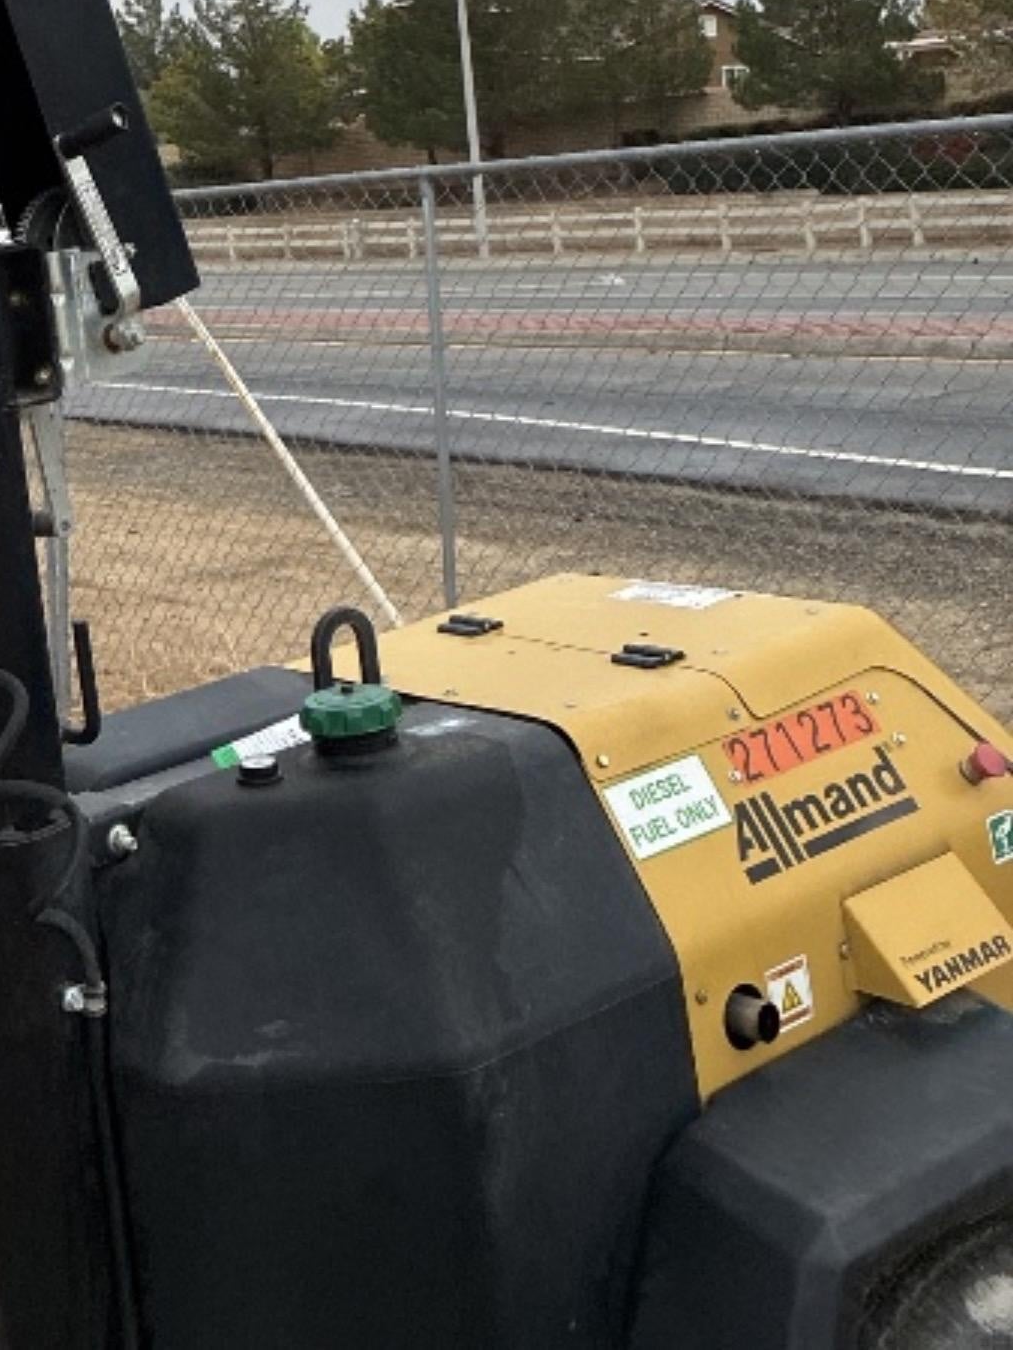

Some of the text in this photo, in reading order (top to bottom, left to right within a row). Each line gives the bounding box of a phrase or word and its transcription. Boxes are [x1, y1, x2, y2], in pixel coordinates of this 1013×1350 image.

[727, 693, 874, 781] 271273
[629, 773, 692, 810] DIESEL
[734, 743, 907, 870] Allmand
[628, 795, 719, 849] FUEL ONLY
[914, 934, 1012, 994] YANMAR
